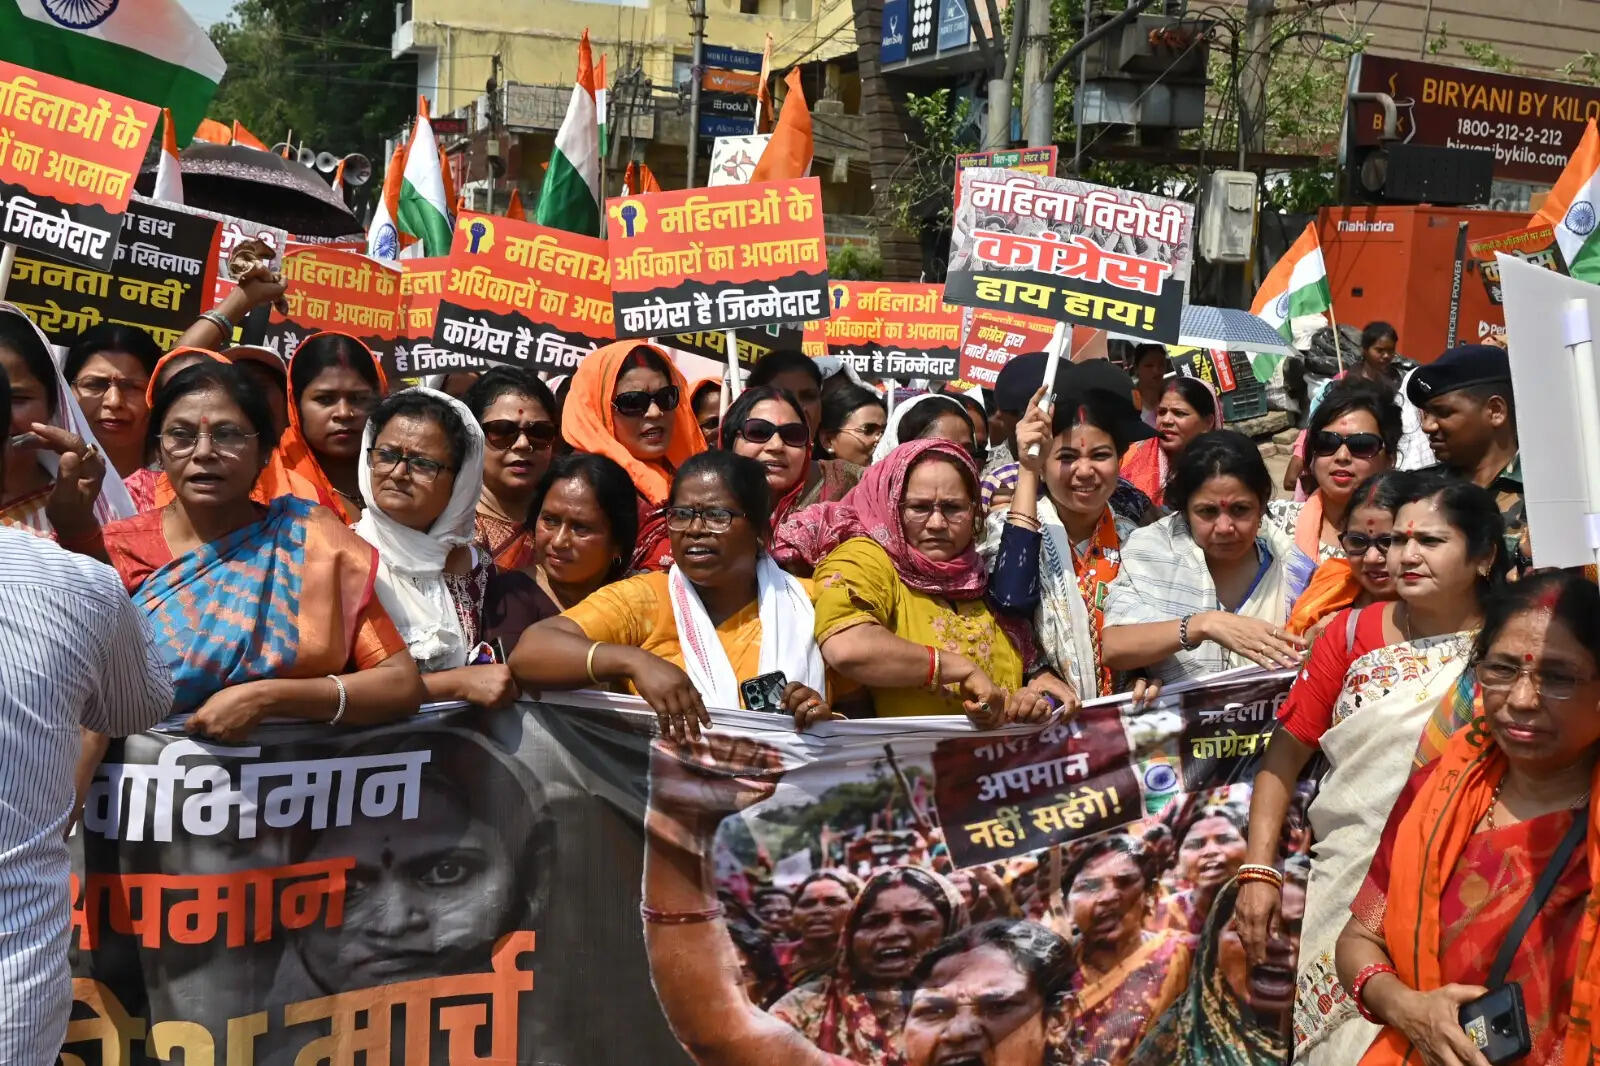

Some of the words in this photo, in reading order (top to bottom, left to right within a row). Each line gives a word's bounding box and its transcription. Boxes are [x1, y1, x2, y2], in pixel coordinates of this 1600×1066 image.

[1422, 77, 1513, 114] BIRYANI
[1518, 91, 1548, 118] BY
[1552, 95, 1600, 123] KILO
[112, 105, 148, 150] के
[1457, 118, 1563, 146] 1800-212-2-212
[12, 139, 44, 176] का
[43, 150, 132, 200] अपमान
[3, 195, 111, 260] जिम्मेदार
[138, 215, 176, 239] हाथ
[656, 188, 782, 234] महिलाओं
[784, 186, 815, 223] के
[970, 176, 1079, 224] महिला
[1081, 190, 1187, 244] विरोधी
[1338, 220, 1394, 232] Mahindra
[130, 242, 203, 276] खिलाफ
[614, 240, 704, 281] अधिकारों
[705, 245, 735, 273] का
[740, 237, 820, 269] अपमान
[971, 230, 1171, 295] कांग्रेस
[1452, 260, 1462, 299] POWER
[11, 256, 114, 298] जनता
[118, 276, 192, 312] नहीं
[375, 266, 397, 297] के
[447, 265, 541, 310] अधिकारों
[540, 285, 569, 316] का
[857, 287, 943, 314] महिलाओं
[973, 275, 1056, 310] हाय
[1061, 289, 1156, 331] हाय!
[307, 297, 331, 321] का
[333, 302, 395, 331] अपमान
[408, 308, 432, 328] का
[621, 296, 692, 332] कांग्रेस
[693, 290, 713, 325] है
[715, 284, 822, 323] जिम्मेदार
[824, 316, 884, 341] अधिकारों
[884, 321, 905, 340] का
[906, 322, 960, 342] अपमान
[1447, 301, 1459, 349] EFFICIENT
[442, 317, 513, 357] कांग्रेस
[514, 326, 533, 360] है
[965, 343, 988, 360] नारी
[978, 325, 1007, 343] कांग्रेस
[395, 345, 409, 372] है
[872, 350, 885, 373] है
[886, 351, 956, 376] जिम्मेदार
[1191, 728, 1260, 760] कांग्रेस
[976, 752, 1090, 801] अपमान
[964, 805, 1027, 849] नहीं
